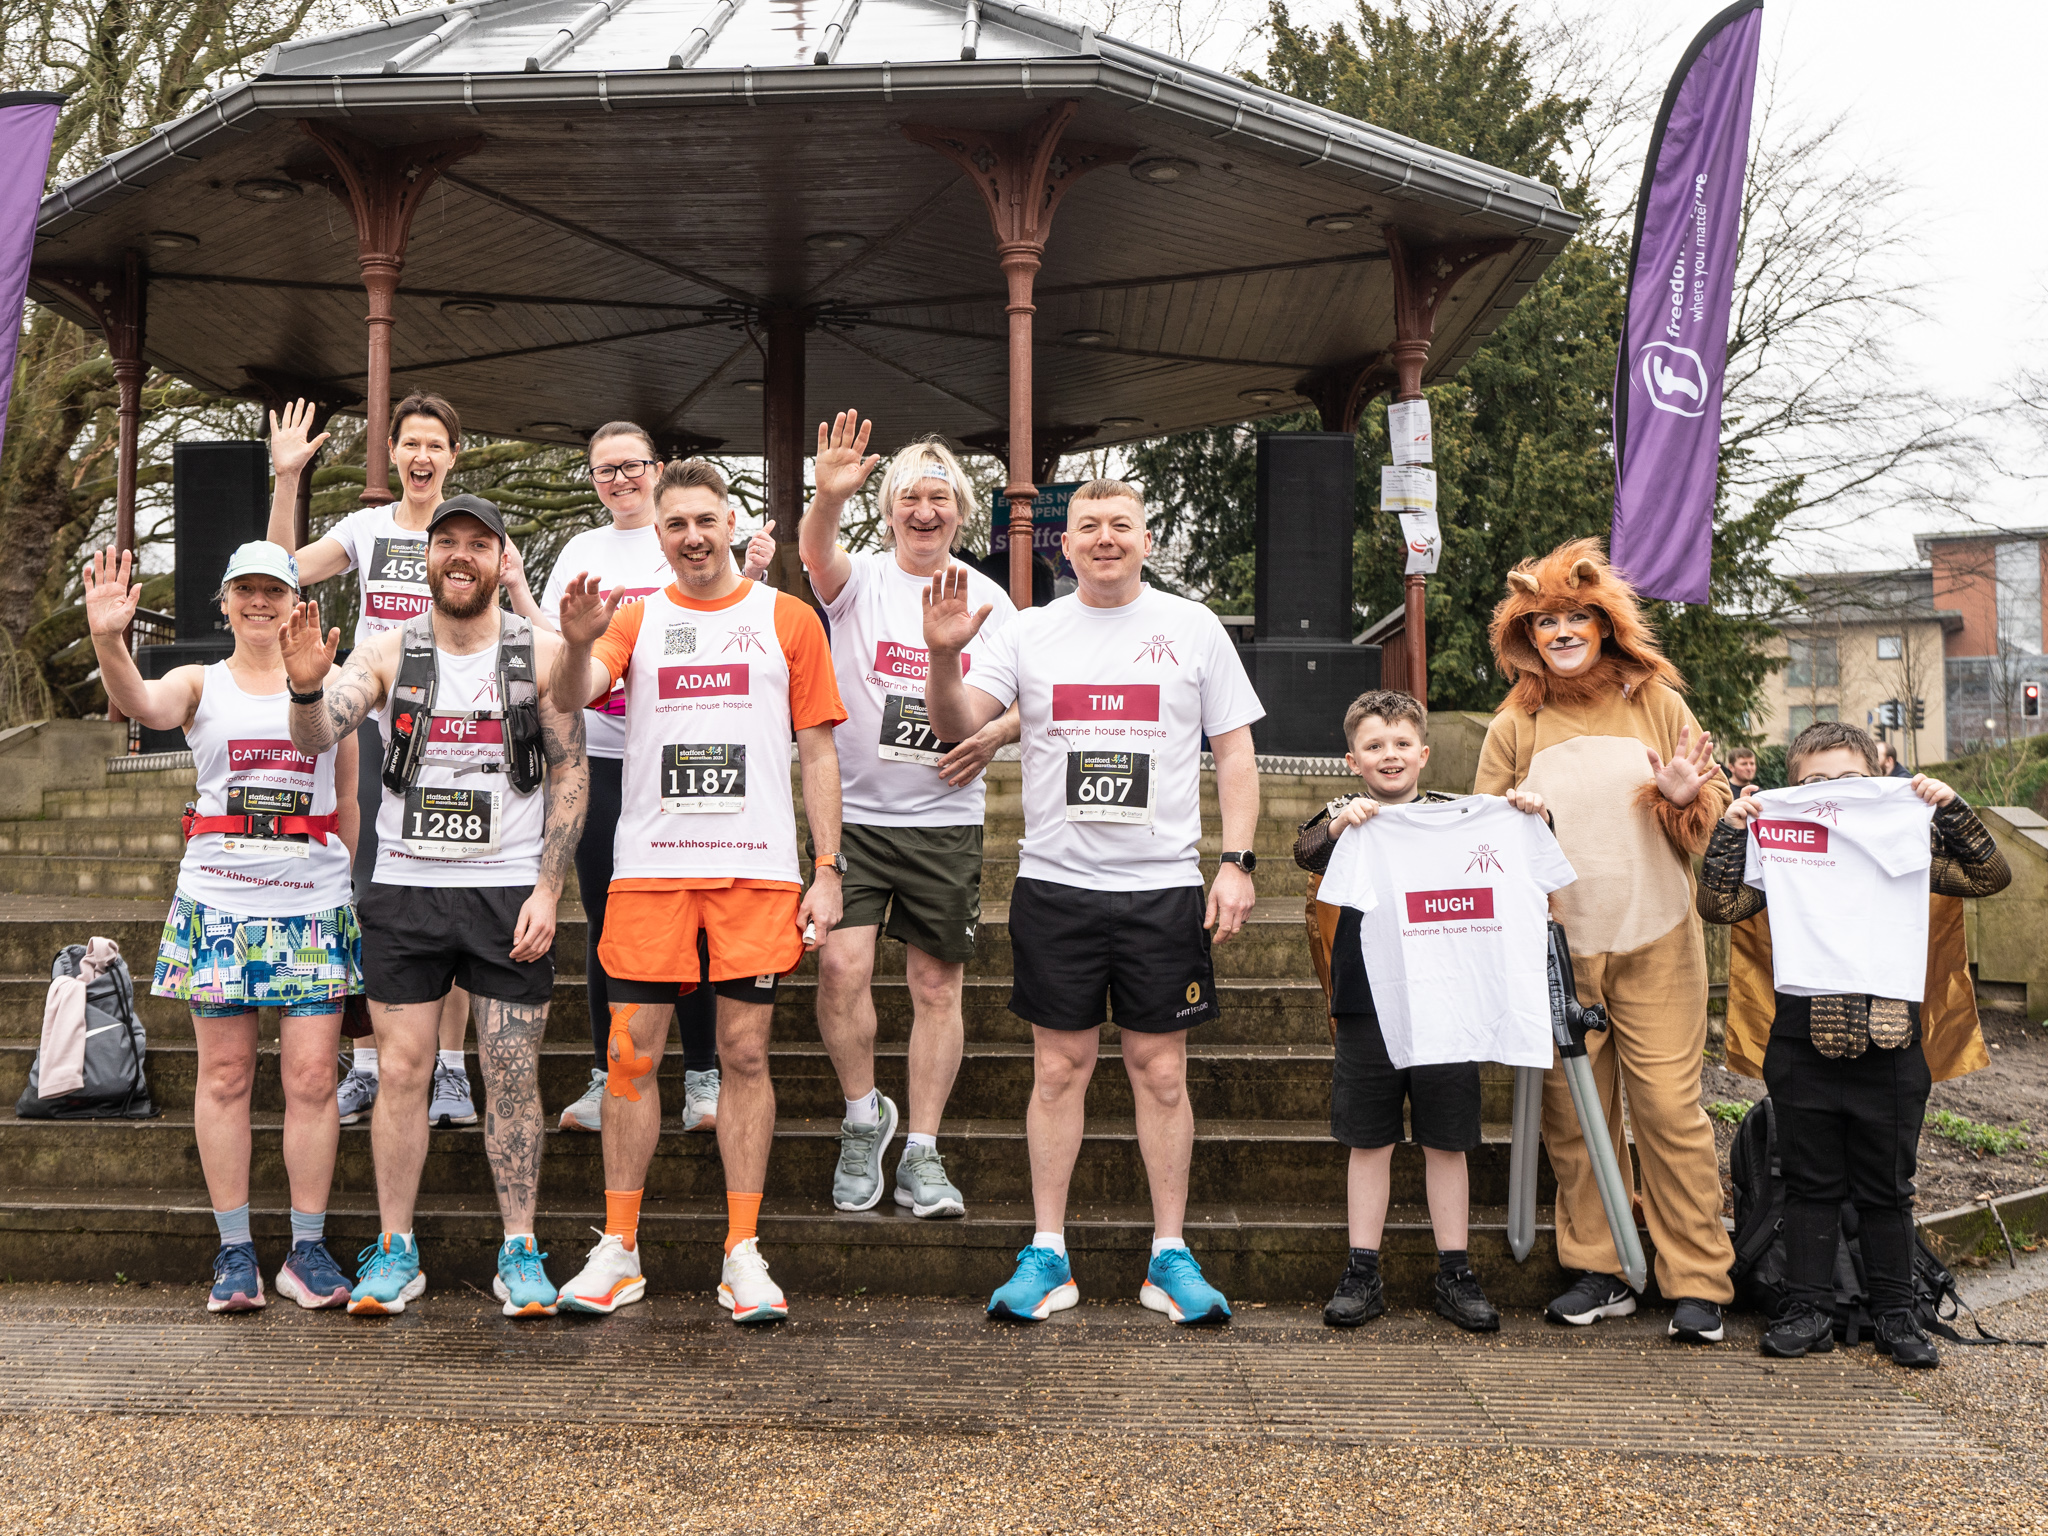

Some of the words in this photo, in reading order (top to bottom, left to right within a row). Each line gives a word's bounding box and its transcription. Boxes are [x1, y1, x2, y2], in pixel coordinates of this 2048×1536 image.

[1696, 203, 1708, 248] matter
[1694, 252, 1709, 277] you
[1690, 280, 1704, 323] where
[1031, 505, 1066, 518] PEN!
[886, 645, 930, 663] ANDRE
[675, 672, 731, 690] ADAM
[865, 674, 908, 692] katharine
[655, 703, 693, 713] katharine
[695, 701, 720, 710] house
[723, 700, 753, 711] hospice
[1088, 694, 1124, 711] TIM
[440, 719, 477, 735] JOE
[1046, 726, 1090, 737] katharine
[1095, 726, 1126, 736] house
[1130, 726, 1167, 739] hospice
[232, 748, 314, 764] CATHERINE
[451, 748, 475, 756] house
[477, 749, 505, 758] hospice
[262, 774, 287, 784] house
[669, 768, 738, 795] 1187
[248, 794, 275, 802] stafford
[1078, 776, 1133, 803] 607
[412, 812, 482, 840] 1288
[650, 839, 768, 851] www.khhospice.org.uk
[1770, 854, 1798, 864] house
[1801, 858, 1836, 868] hospice
[200, 864, 315, 889] www.khhospice.org.uk
[1425, 896, 1475, 914] HUGH
[1402, 926, 1440, 937] katharine
[1443, 925, 1468, 934] house
[1470, 923, 1503, 934] hospice
